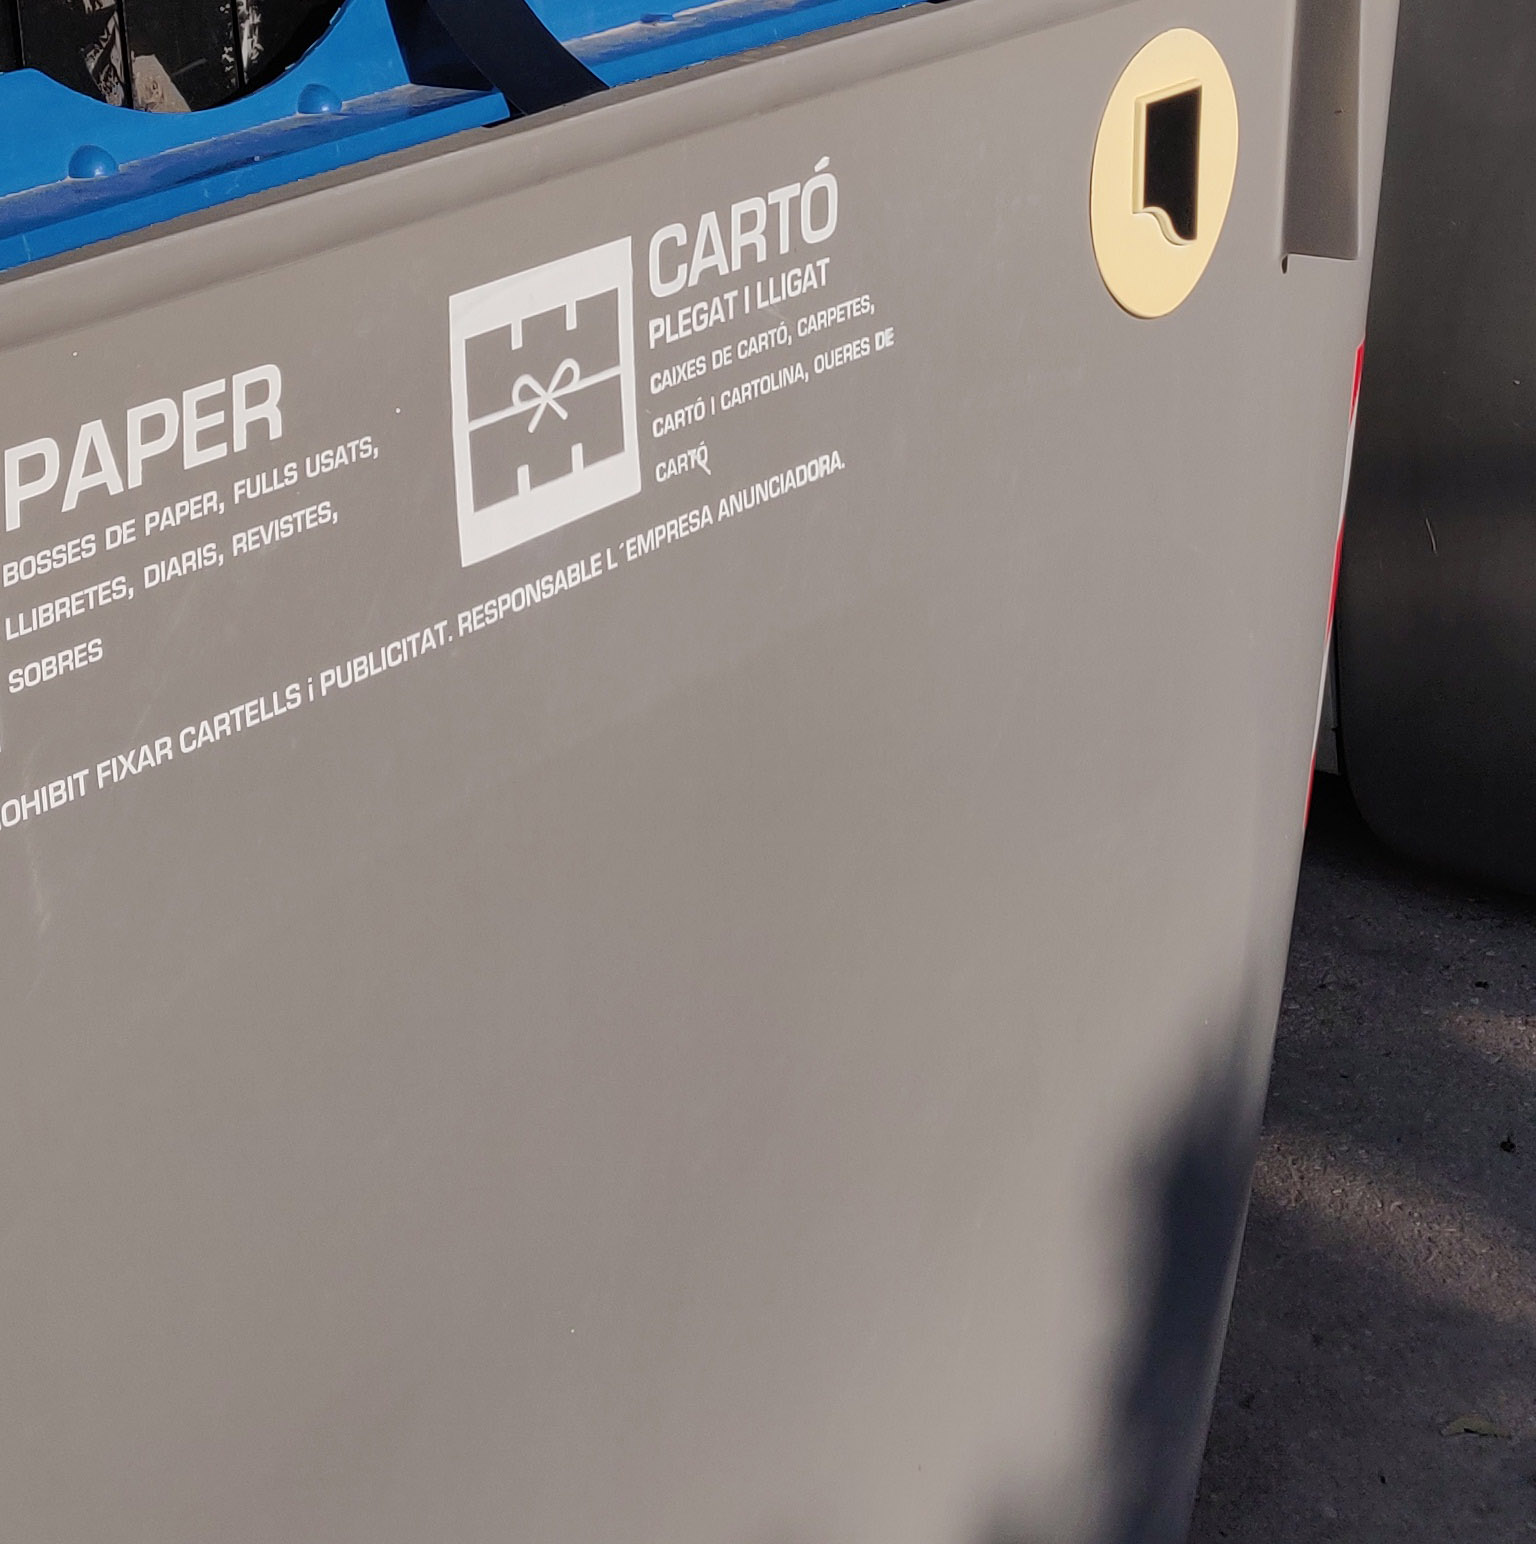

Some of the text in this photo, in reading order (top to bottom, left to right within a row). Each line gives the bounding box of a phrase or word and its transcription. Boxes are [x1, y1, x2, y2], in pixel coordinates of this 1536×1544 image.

[648, 155, 839, 298] CARTÓ
[648, 256, 831, 350] PLEGAT I LLIGAT
[649, 294, 876, 395] CAIXES DE CARTÓ, CARPETES,
[652, 326, 895, 438] CARTÓ I CARTOLINA, OUERES DE
[3, 363, 283, 532] PAPER
[655, 440, 709, 483] CARTÓ
[2, 435, 379, 587] BOSSES DE PAPER, FULLS USATS,
[4, 500, 338, 641] LLIBRETES, DIARIS, REVISTES,
[8, 637, 104, 694] SOBRES
[96, 735, 174, 790] FIXAR
[179, 682, 302, 754] CARTELLS
[319, 619, 454, 697] PUBLICITAT.
[457, 552, 603, 638] RESPONSABLE
[717, 449, 846, 522] ANUNCIADORA.
